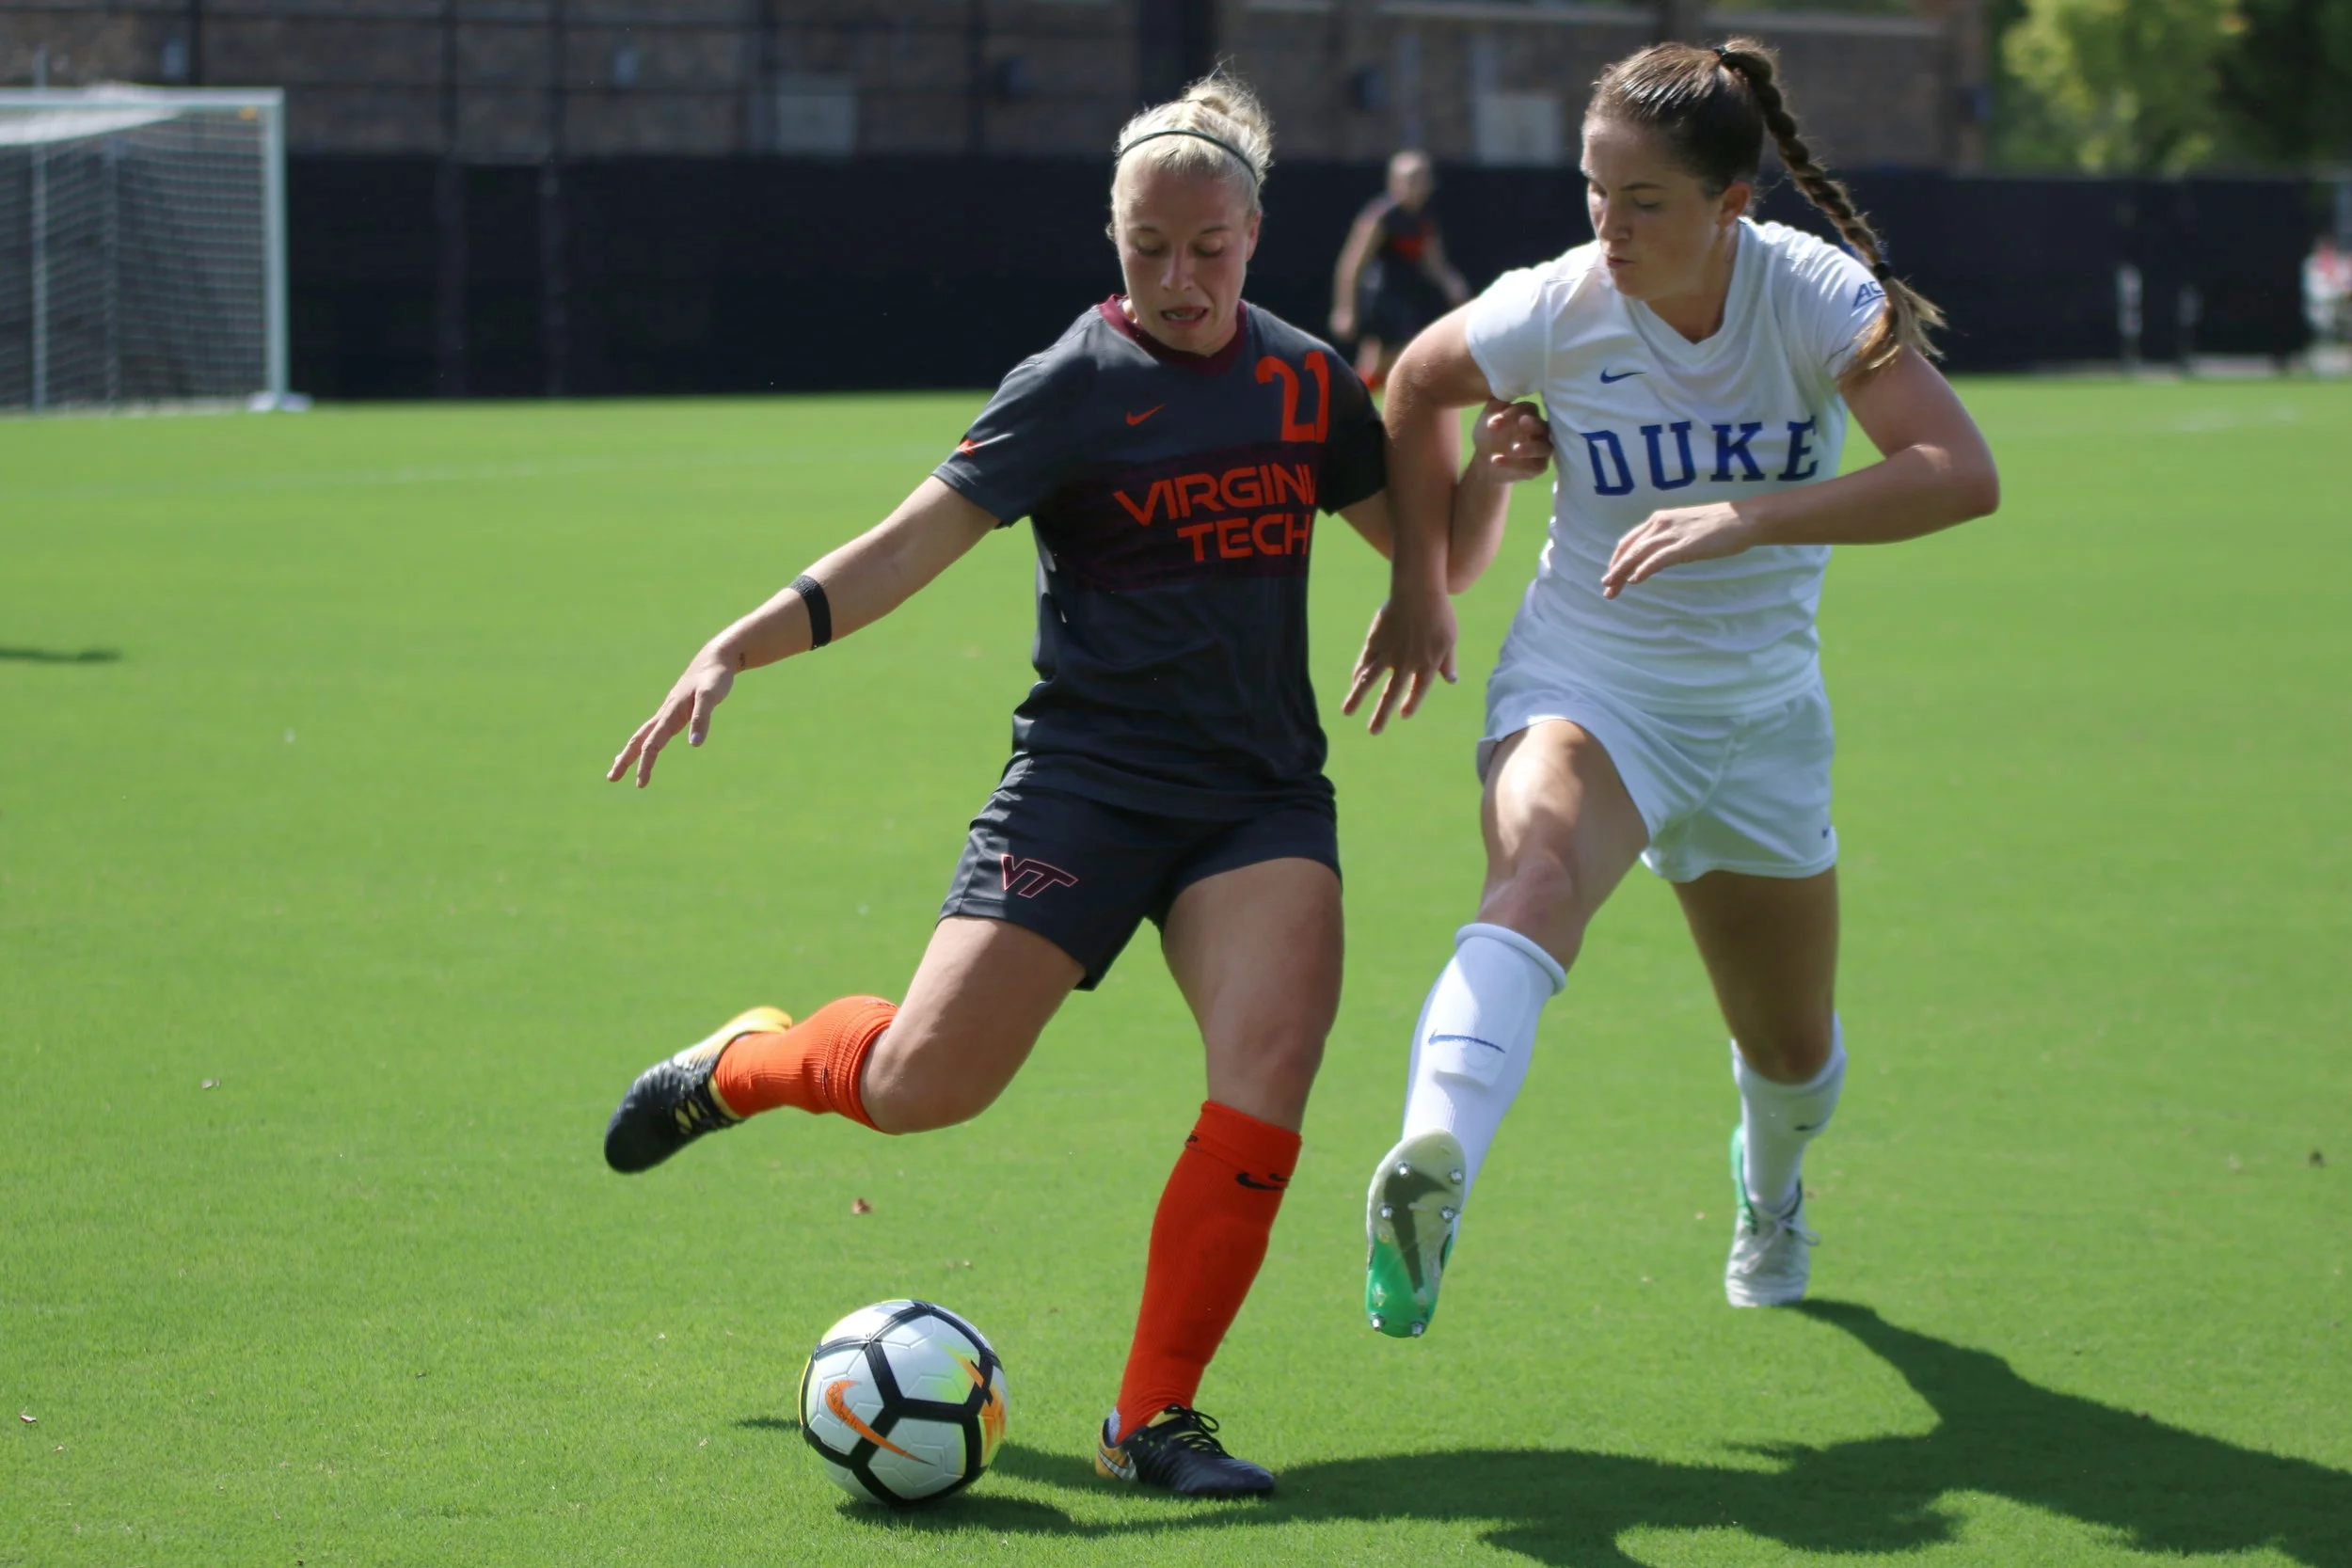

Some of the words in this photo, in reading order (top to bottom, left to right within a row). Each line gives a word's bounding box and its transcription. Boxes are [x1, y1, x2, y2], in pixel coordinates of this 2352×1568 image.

[1851, 280, 1883, 309] AC
[1255, 351, 1329, 443] 21
[1581, 416, 1818, 496] DUKE
[1112, 462, 1315, 527] VIRGINI
[1177, 513, 1311, 562] TECH
[1001, 853, 1079, 898] VT
